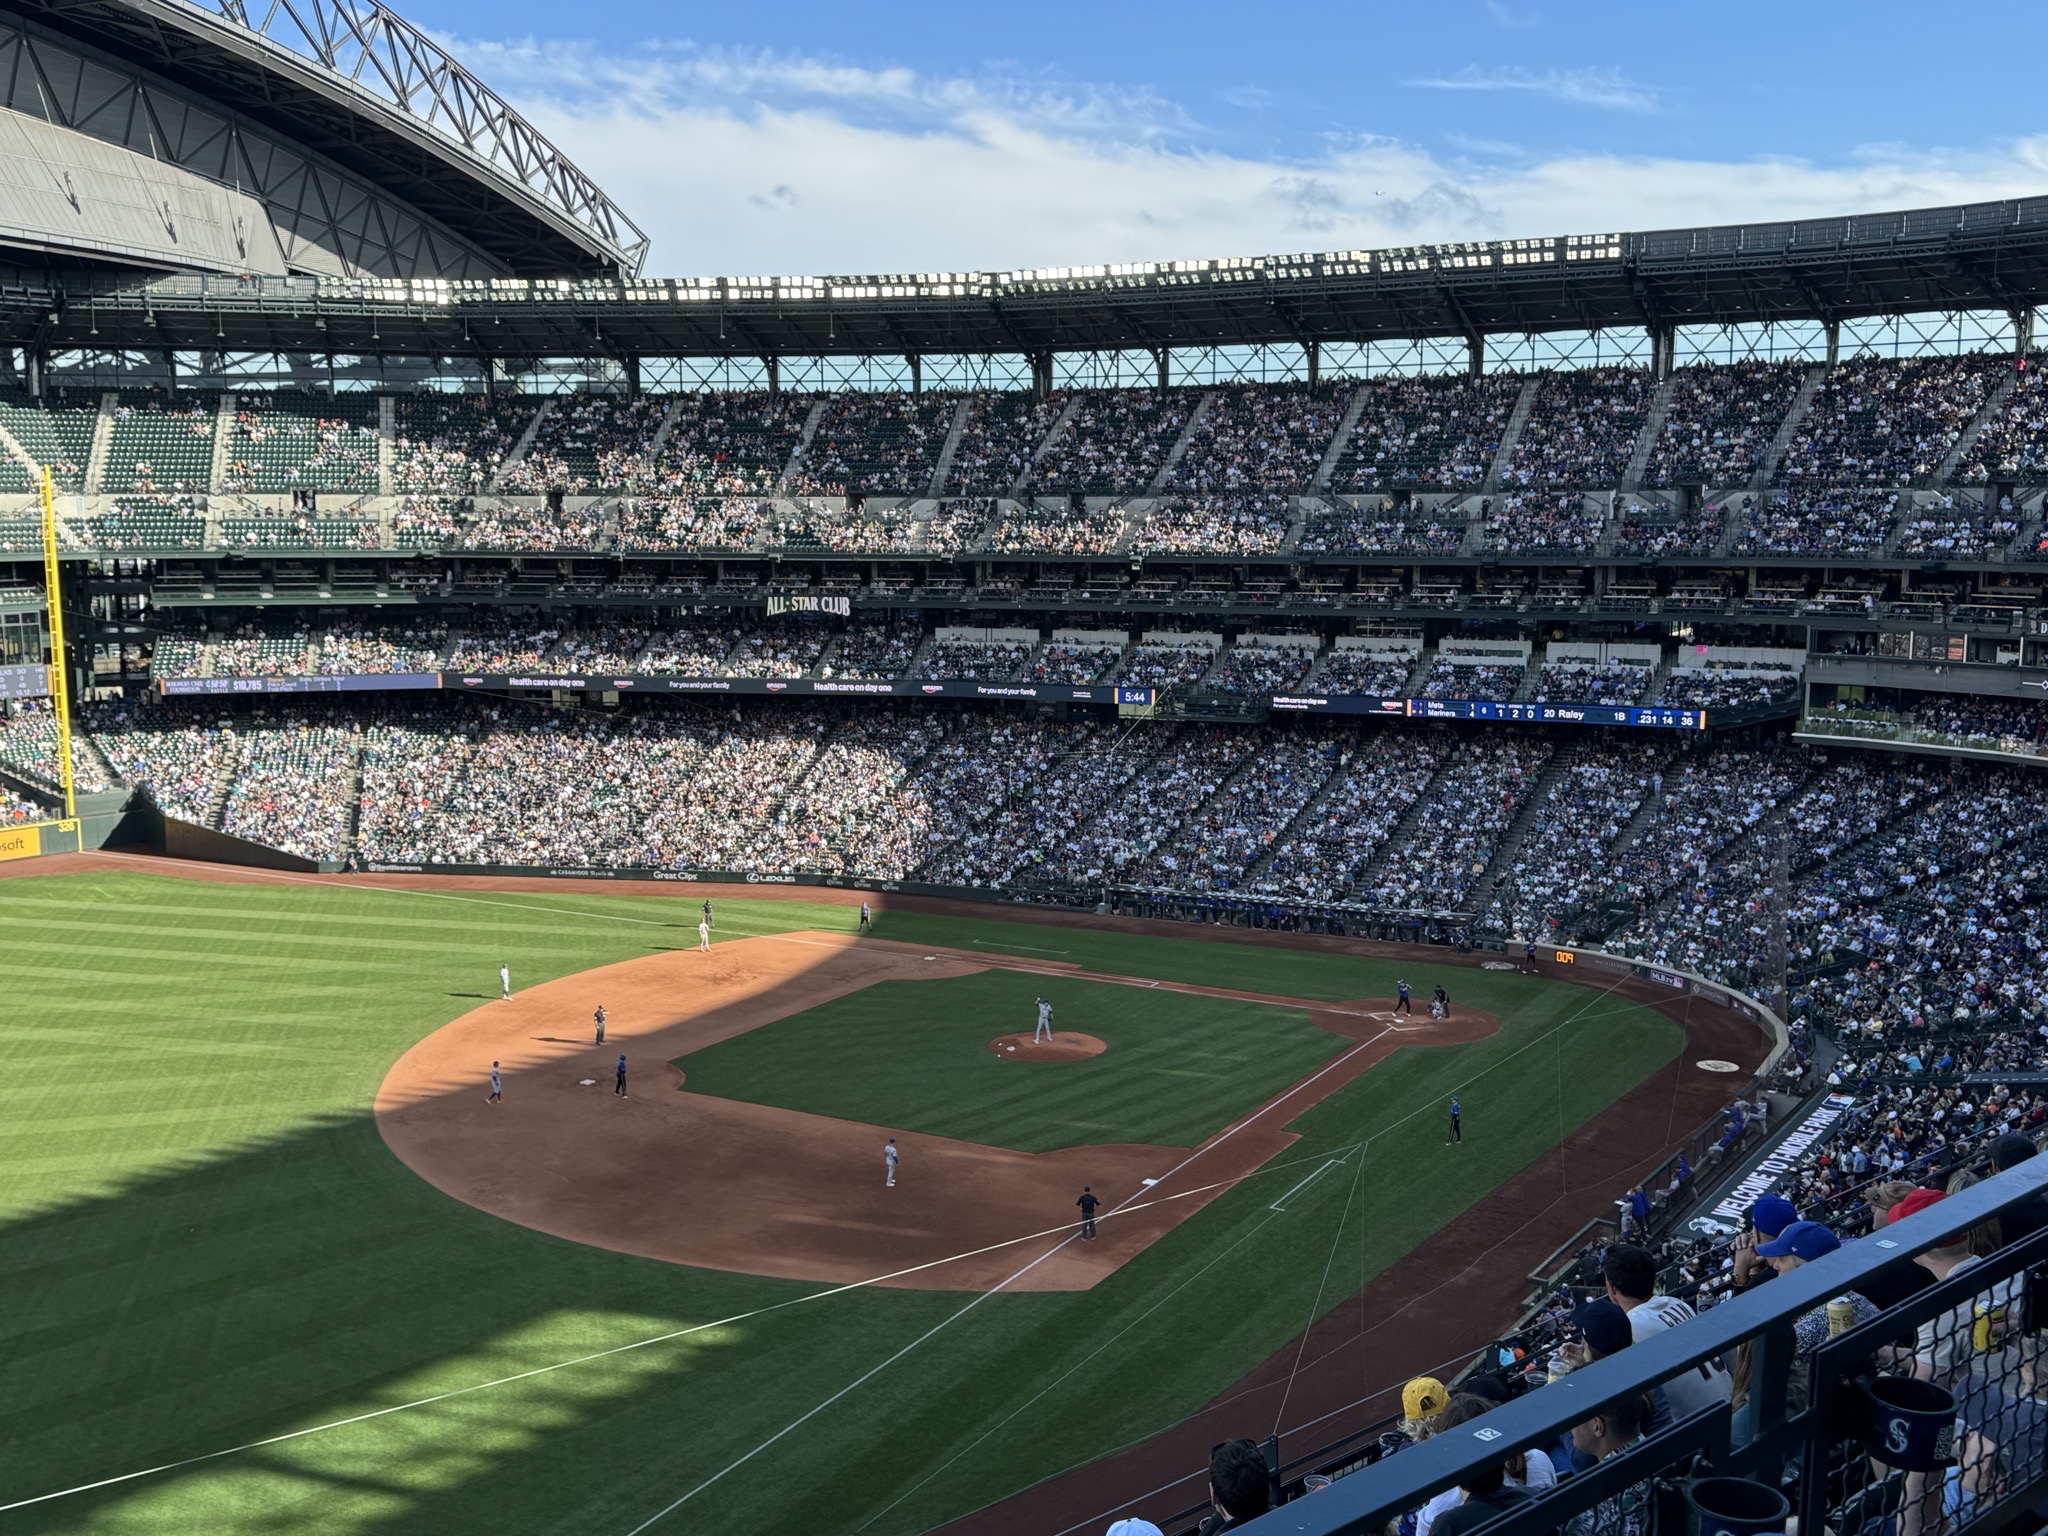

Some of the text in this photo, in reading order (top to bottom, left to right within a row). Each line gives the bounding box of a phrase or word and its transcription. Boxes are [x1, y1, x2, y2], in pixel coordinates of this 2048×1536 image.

[821, 597, 850, 616] CLUB
[509, 677, 532, 687] Health
[558, 679, 571, 688] day
[713, 681, 730, 690] family
[814, 682, 837, 691] Health
[864, 683, 877, 692] day
[878, 684, 892, 692] one
[987, 687, 997, 695] you
[1020, 688, 1037, 696] family
[1124, 692, 1145, 702] 5:44
[1427, 701, 1444, 709] Mets
[1427, 709, 1456, 717] Mariners
[1498, 709, 1503, 717] 1
[1512, 709, 1519, 718] 2
[1527, 710, 1534, 719] 0
[1543, 709, 1585, 720] 20 Raley
[1614, 712, 1626, 721] 1B
[1637, 715, 1657, 724] .231
[1662, 716, 1673, 724] 14
[1681, 717, 1693, 726] 36
[0, 837, 24, 851] soft
[653, 870, 698, 881] Great Clips
[760, 874, 796, 882] LEXUS
[1711, 1106, 1842, 1219] WELCOME TO T-MOBILE PARK
[1478, 1429, 1500, 1439] 12
